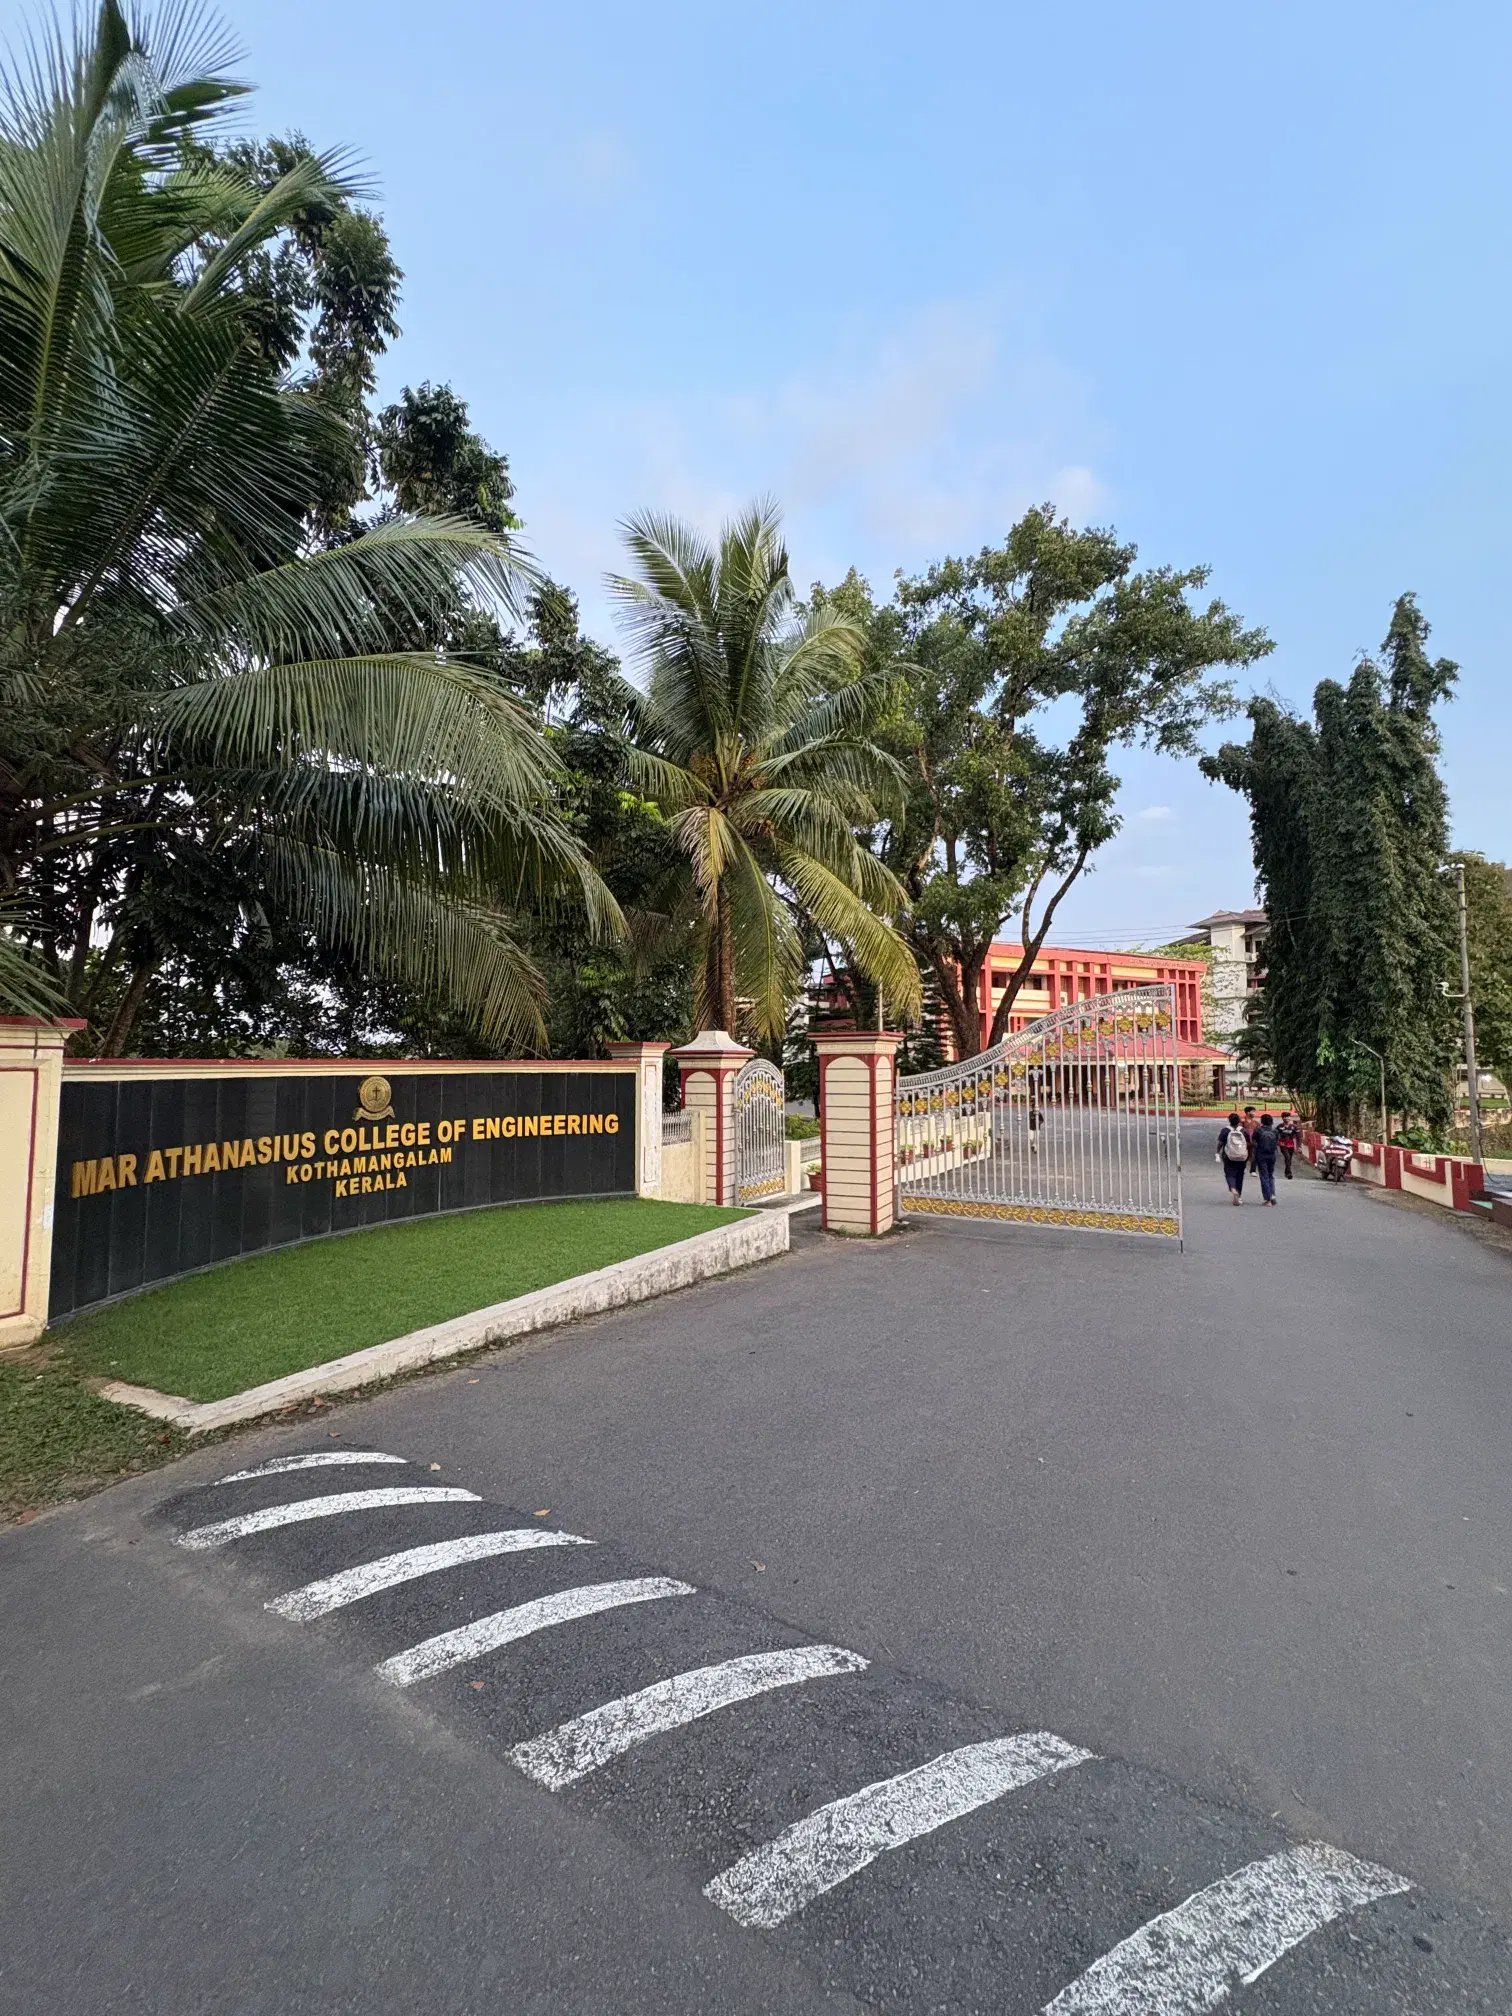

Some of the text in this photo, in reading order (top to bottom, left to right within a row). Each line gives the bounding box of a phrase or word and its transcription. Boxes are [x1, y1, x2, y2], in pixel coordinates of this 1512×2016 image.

[71, 1113, 619, 1198] MAR ATHANASIUS COLLEGE OF ENGINEERING
[286, 1147, 453, 1184] KOTHAMANGALAM
[335, 1171, 408, 1198] KERALA
